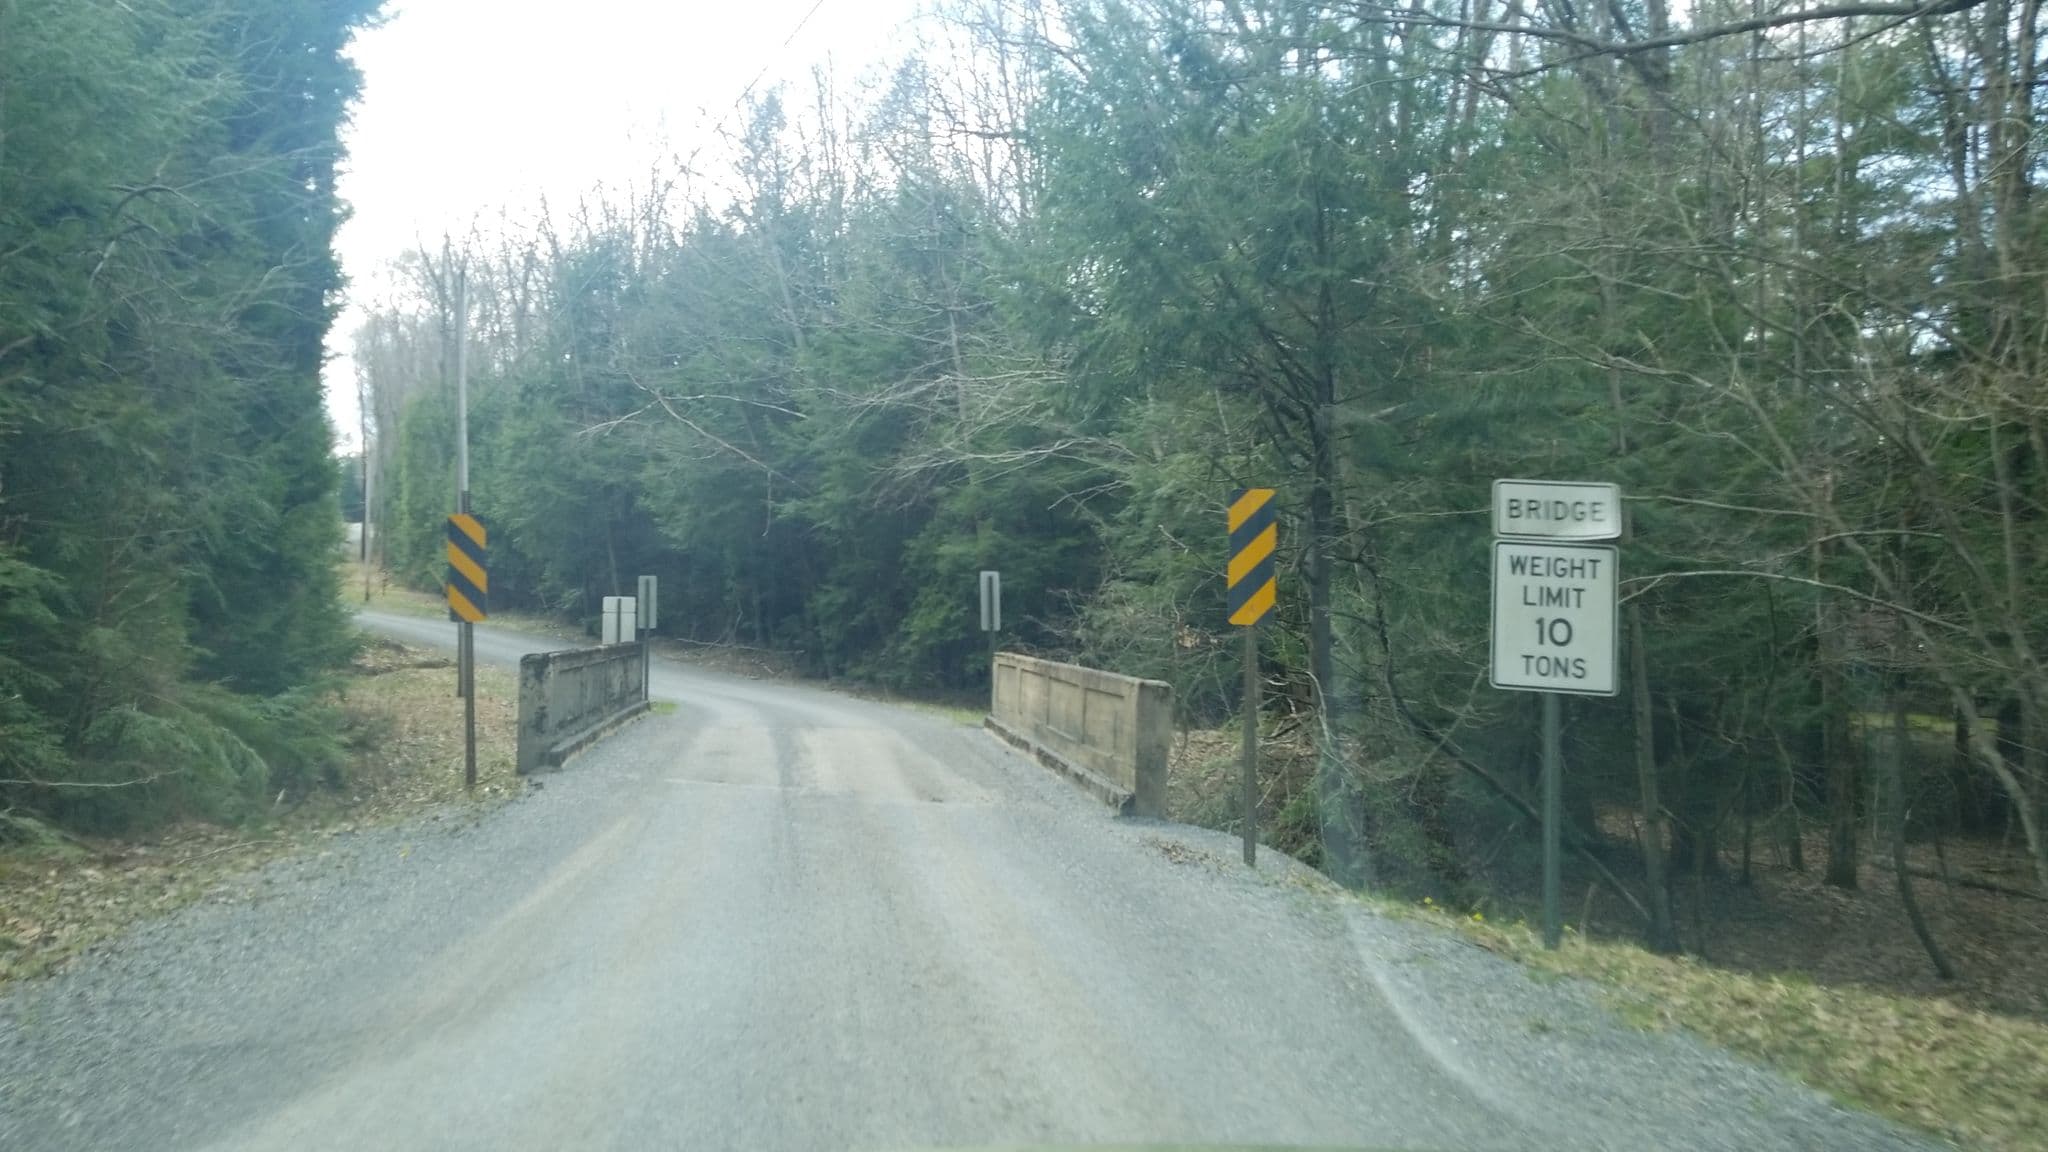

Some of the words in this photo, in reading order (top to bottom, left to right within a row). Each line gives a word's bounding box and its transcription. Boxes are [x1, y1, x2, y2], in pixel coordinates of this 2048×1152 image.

[1507, 498, 1606, 522] BRIDGE
[1510, 555, 1601, 579] WEIGHT
[1522, 585, 1586, 608] LIMIT
[1536, 617, 1573, 647] 10
[1521, 654, 1587, 679] TONS
